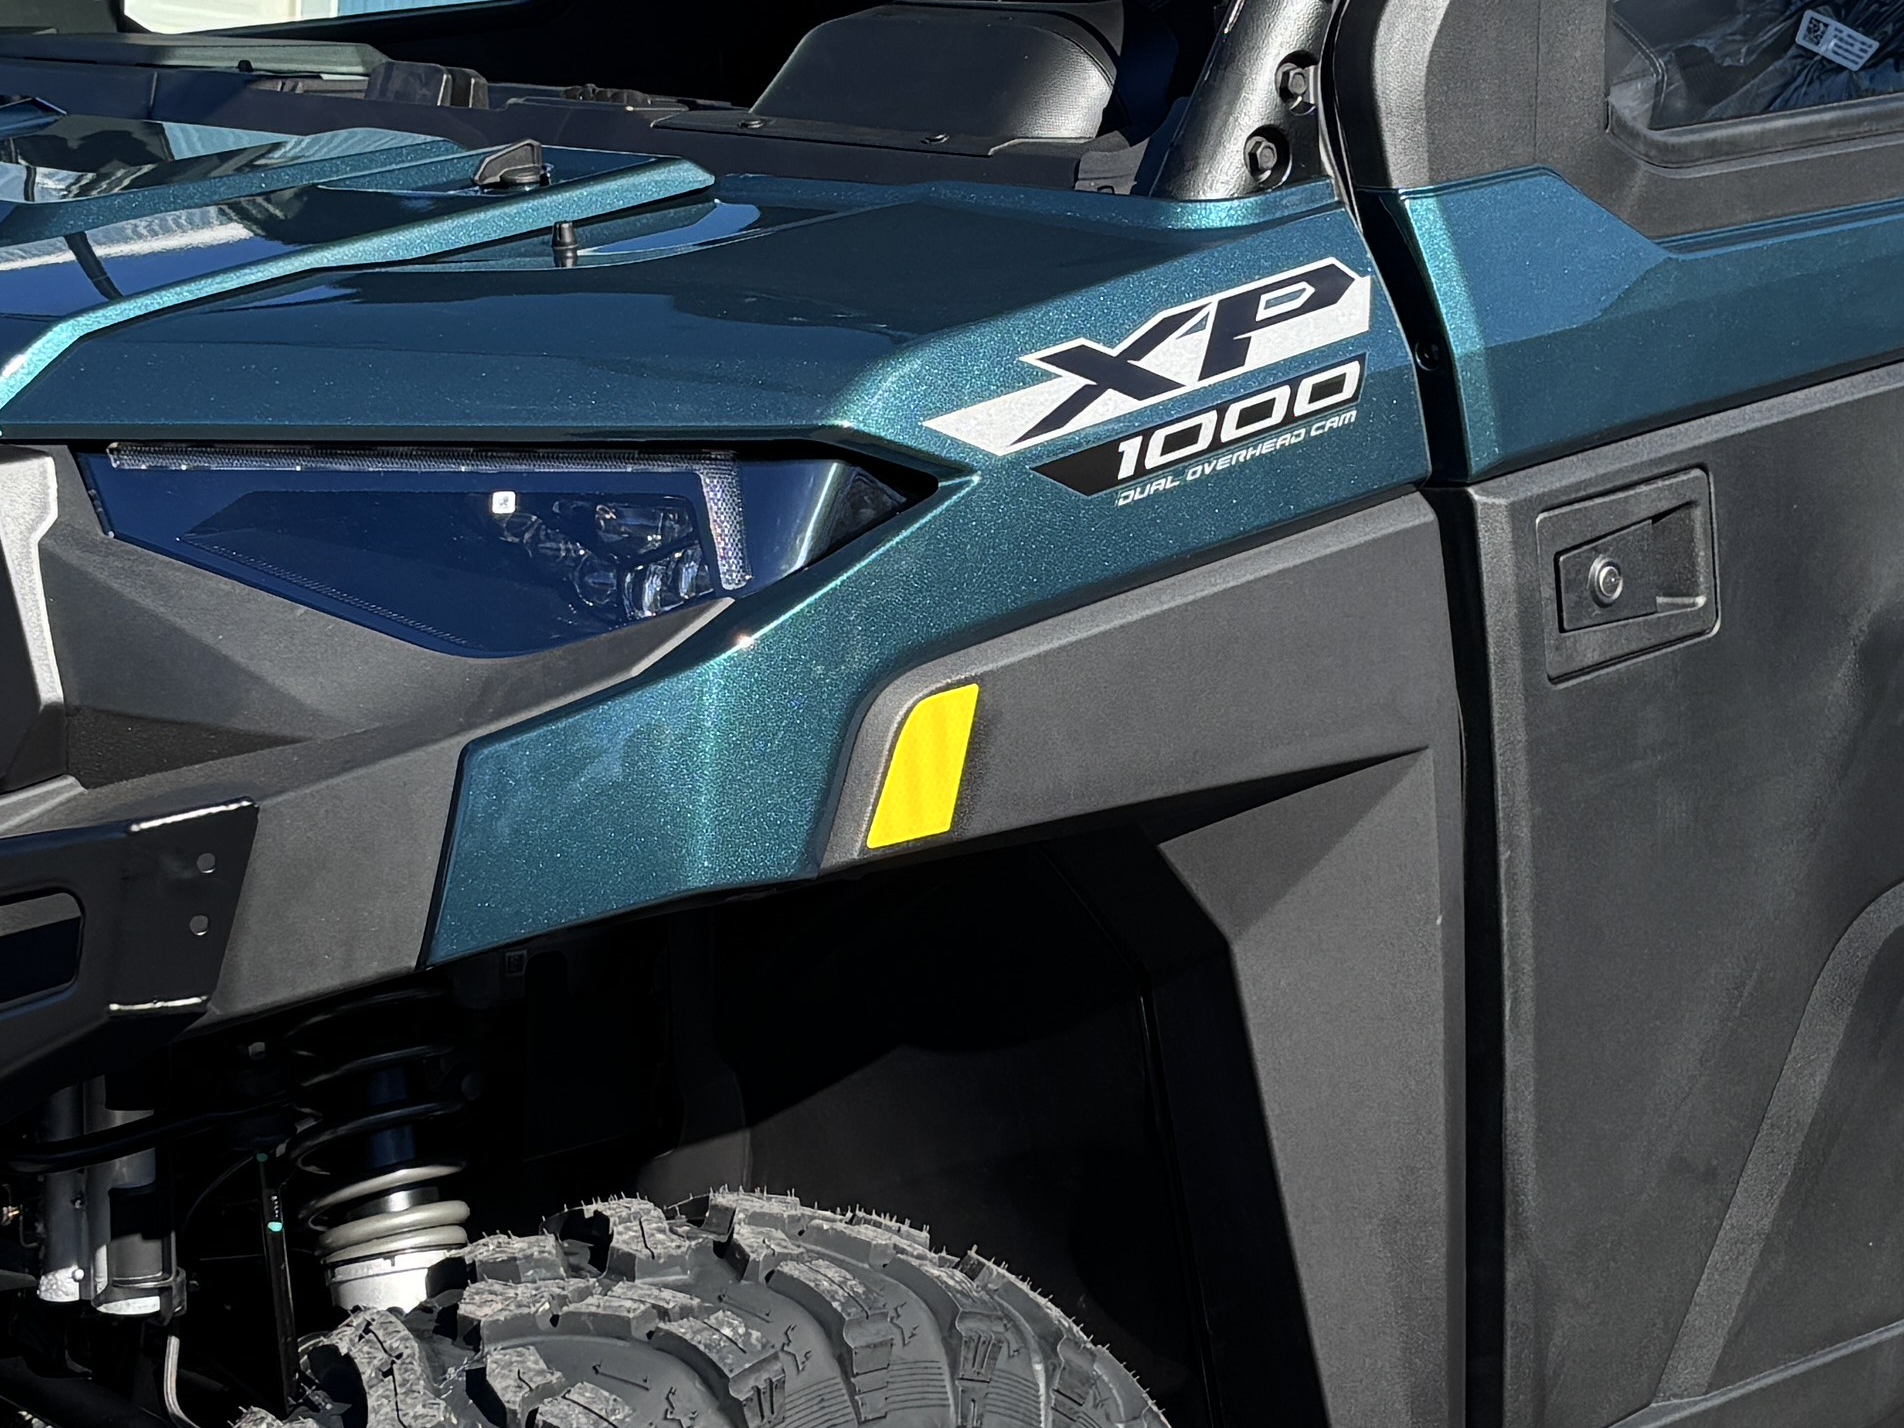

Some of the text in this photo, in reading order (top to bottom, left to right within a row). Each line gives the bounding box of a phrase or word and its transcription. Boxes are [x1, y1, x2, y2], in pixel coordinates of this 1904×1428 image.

[1008, 262, 1356, 445] XP
[1117, 360, 1360, 480] 1000
[1117, 409, 1357, 507] DUAL OVERHEAD CAM
